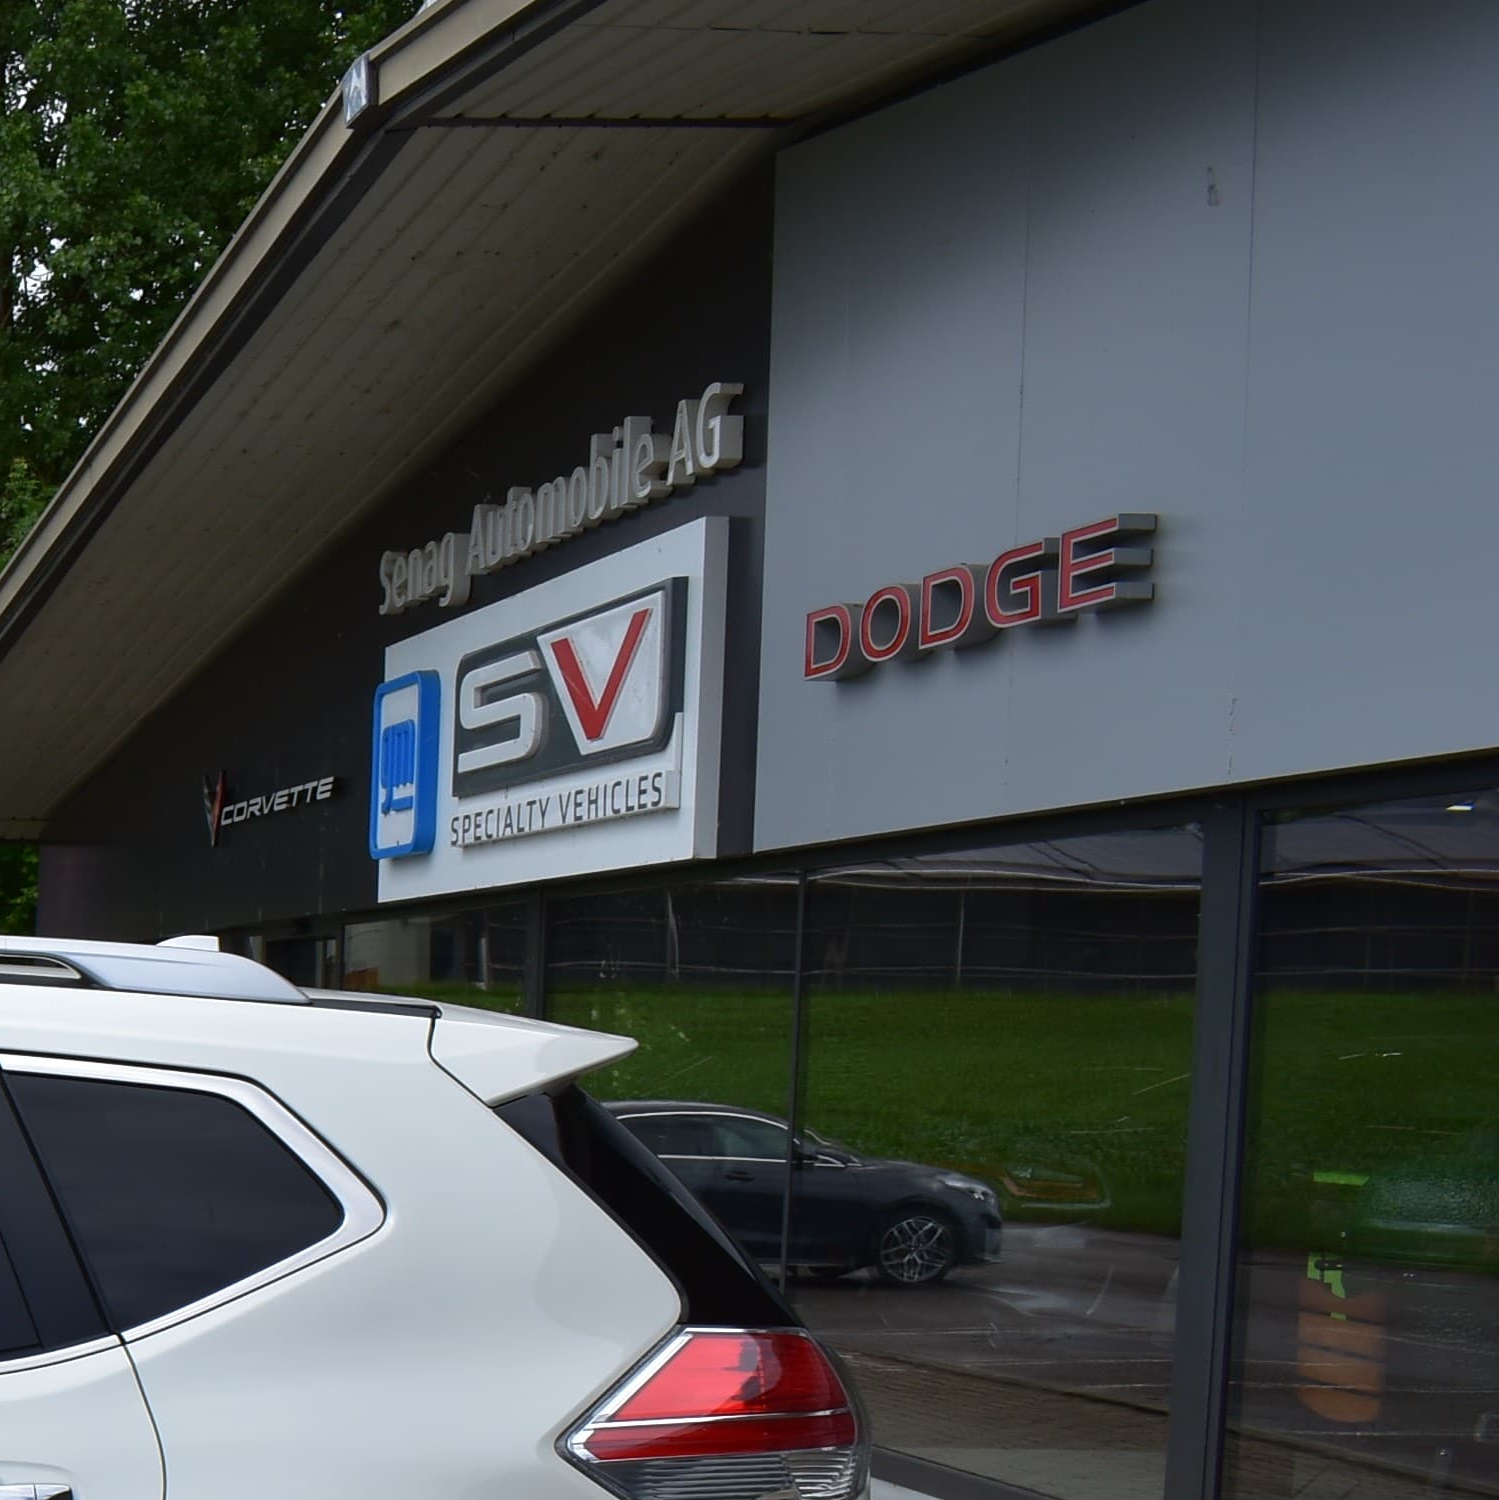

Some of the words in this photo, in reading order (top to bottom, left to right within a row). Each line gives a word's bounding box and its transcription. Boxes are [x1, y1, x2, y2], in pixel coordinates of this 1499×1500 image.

[379, 532, 459, 615] Senag
[466, 416, 655, 576] Automobile
[667, 382, 744, 486] AG
[804, 513, 1153, 681] DODGE
[458, 607, 653, 774] SV
[220, 776, 334, 826] CORVETTE
[450, 796, 551, 847] SPECIALTY
[559, 771, 663, 824] VEHICLES
